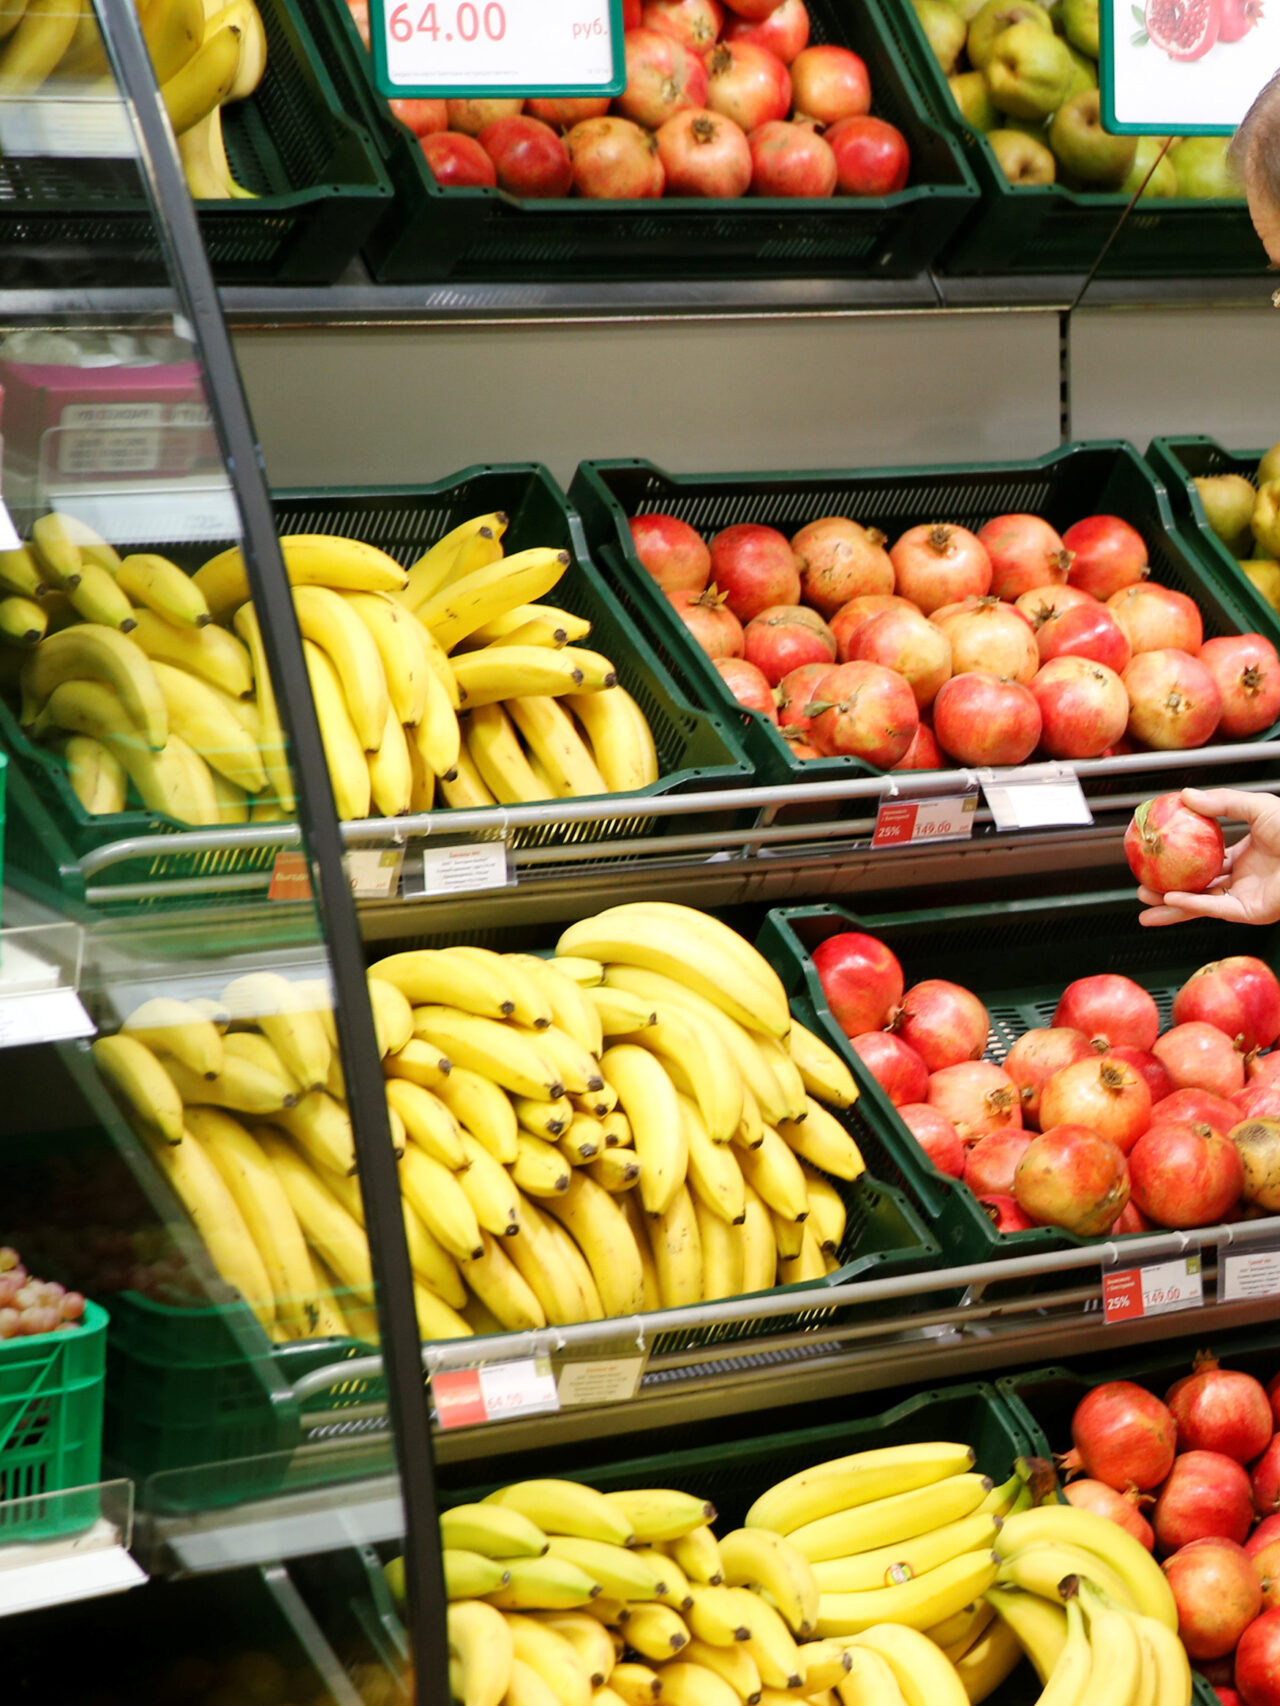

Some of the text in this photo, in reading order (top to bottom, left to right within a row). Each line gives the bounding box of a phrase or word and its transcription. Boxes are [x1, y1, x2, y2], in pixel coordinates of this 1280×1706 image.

[389, 2, 609, 43] 64.00 руб.
[877, 824, 902, 839] 25%
[1107, 1294, 1131, 1311] 25%
